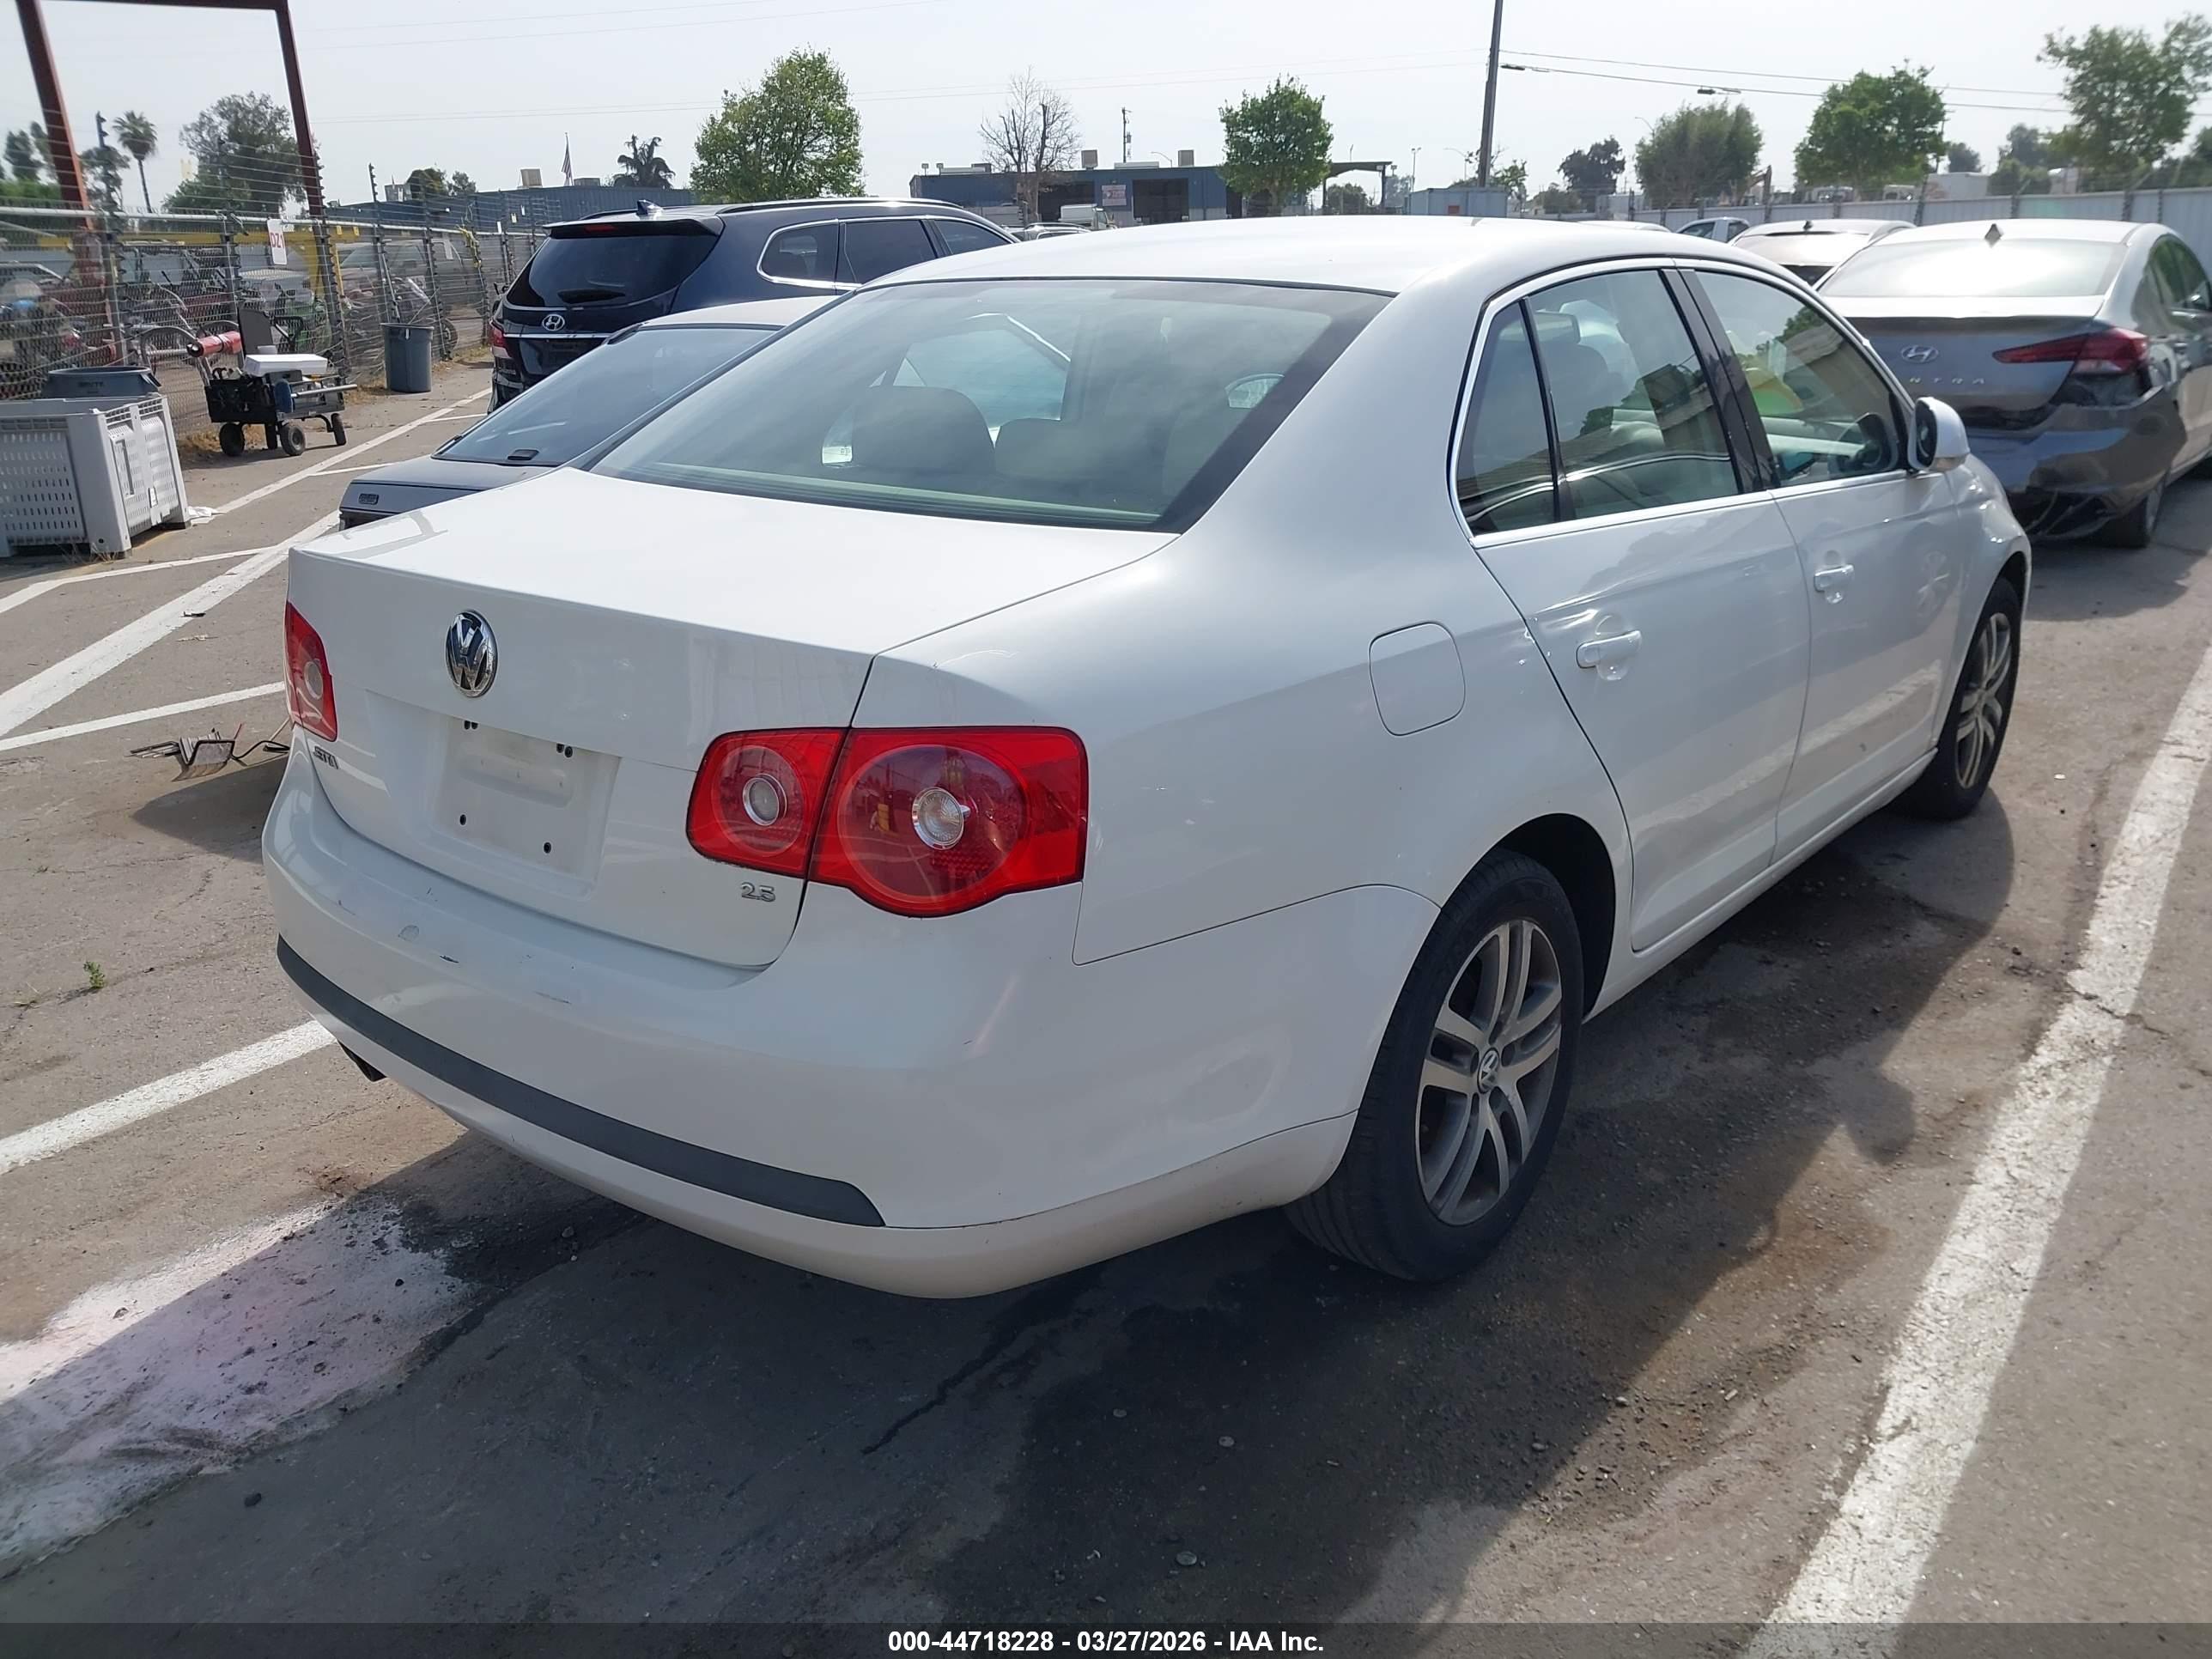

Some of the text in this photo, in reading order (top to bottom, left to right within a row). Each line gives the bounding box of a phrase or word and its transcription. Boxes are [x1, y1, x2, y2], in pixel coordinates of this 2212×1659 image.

[270, 233, 284, 249] DZ1
[1909, 376, 1985, 385] NTRA
[741, 881, 776, 902] 2.5
